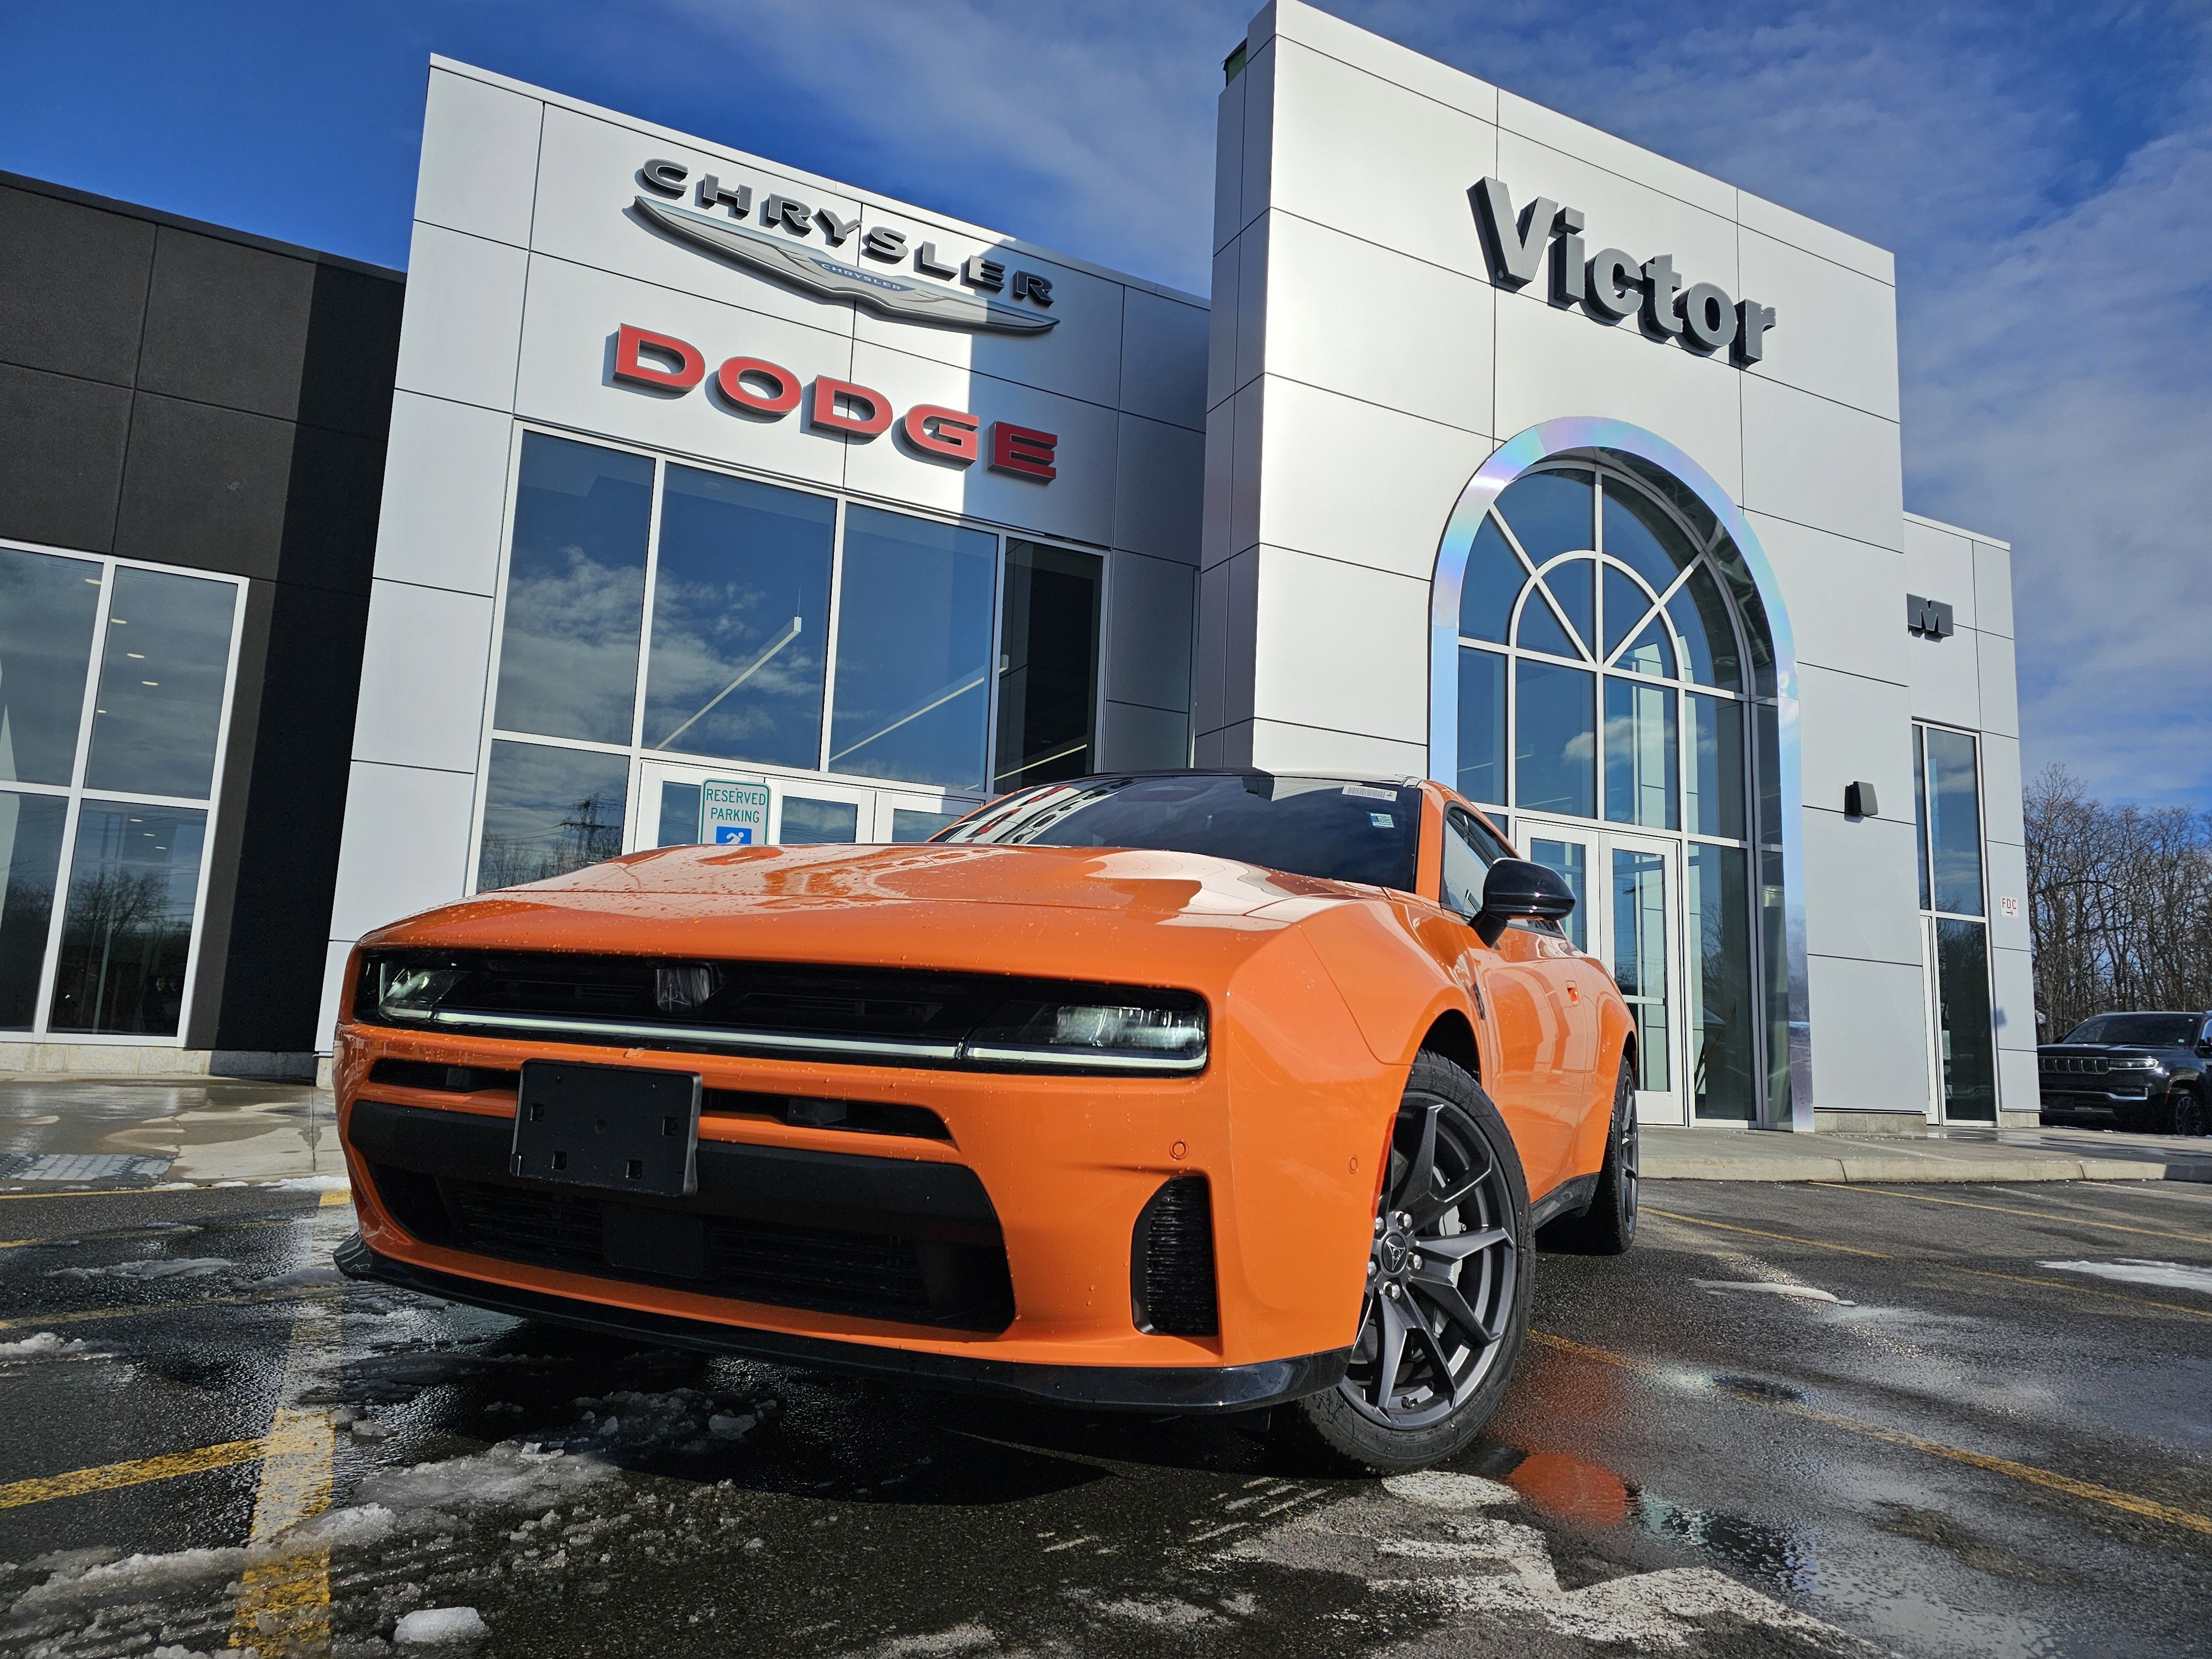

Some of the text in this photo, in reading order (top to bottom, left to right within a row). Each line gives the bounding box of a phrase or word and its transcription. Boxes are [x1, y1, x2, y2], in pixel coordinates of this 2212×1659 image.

[641, 158, 1055, 306] CHRYSLER
[821, 264, 901, 290] CHRYSLER
[1468, 176, 1776, 365] Victor
[613, 323, 1058, 484] DODGE
[706, 789, 766, 806] RESERVED
[711, 807, 760, 823] PARKING
[2002, 898, 2017, 910] FDC
